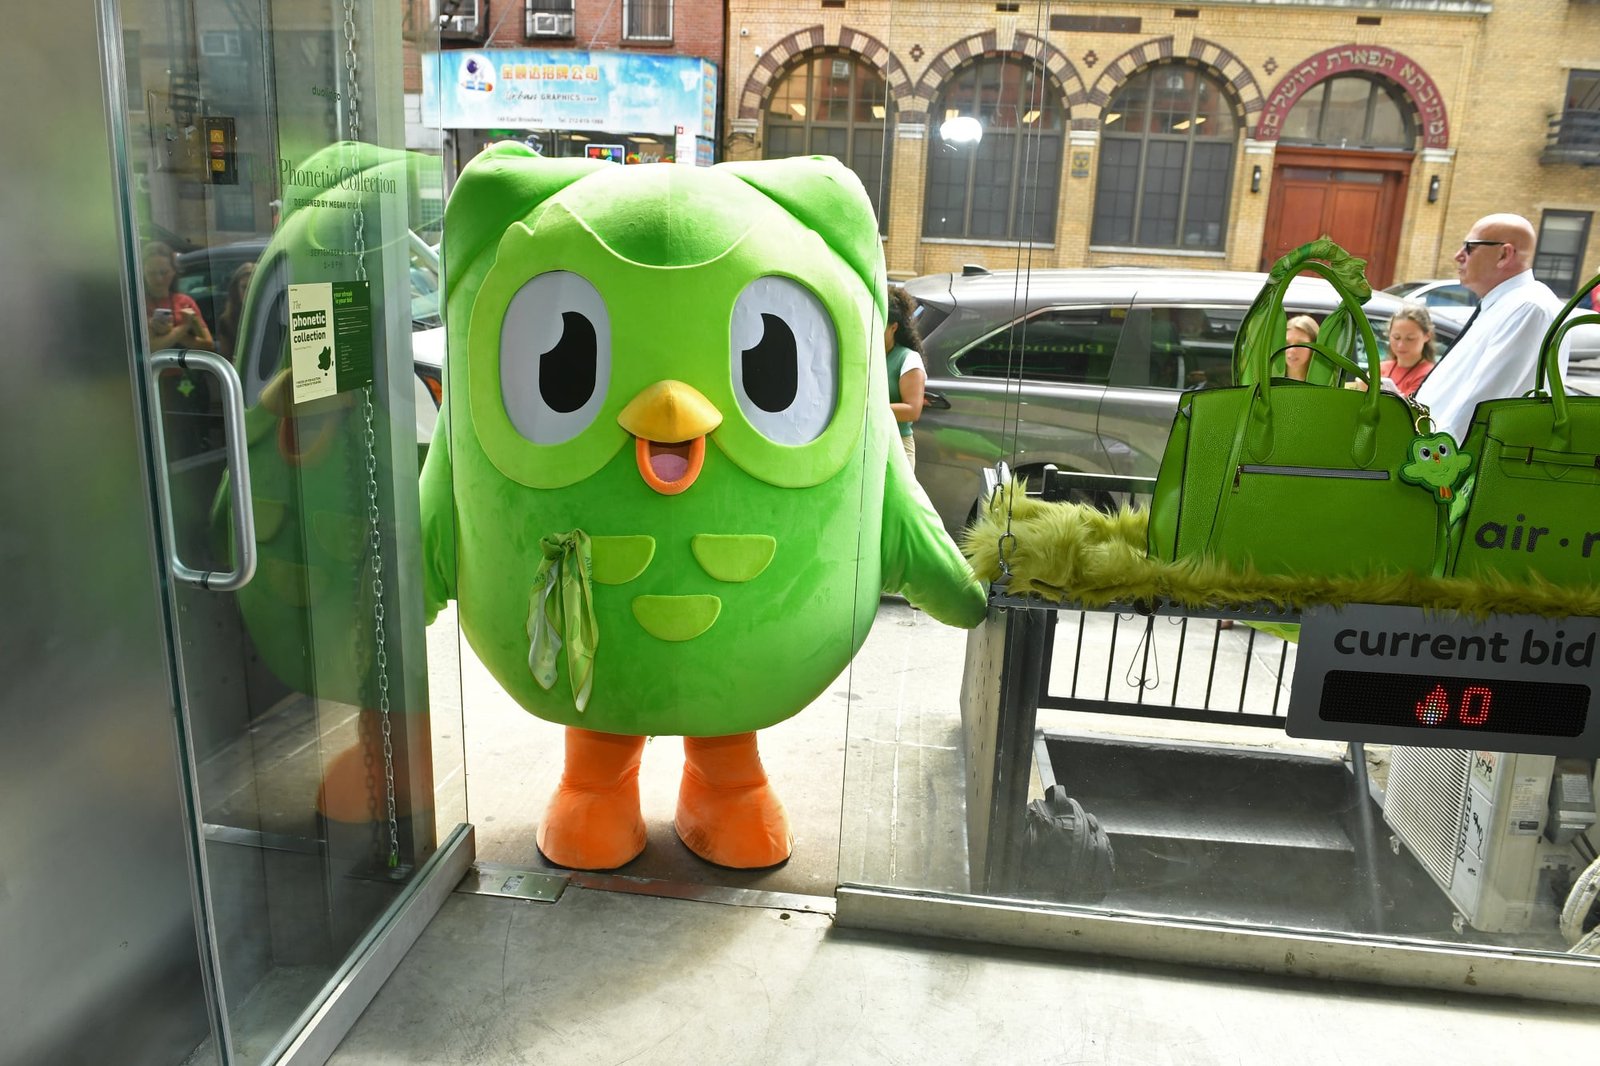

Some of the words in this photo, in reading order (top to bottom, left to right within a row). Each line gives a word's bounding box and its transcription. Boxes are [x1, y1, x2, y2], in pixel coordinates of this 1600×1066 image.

[1326, 50, 1395, 70] תפארת
[1264, 61, 1318, 127] ירושלים
[279, 158, 337, 189] Phonetic
[339, 166, 396, 194] Collection
[294, 198, 320, 208] DESIGNED
[321, 200, 328, 208] BY
[292, 312, 326, 331] phonetic
[293, 330, 327, 343] collection
[1333, 628, 1510, 664] current
[1520, 628, 1597, 668] bid
[1459, 686, 1493, 726] 0
